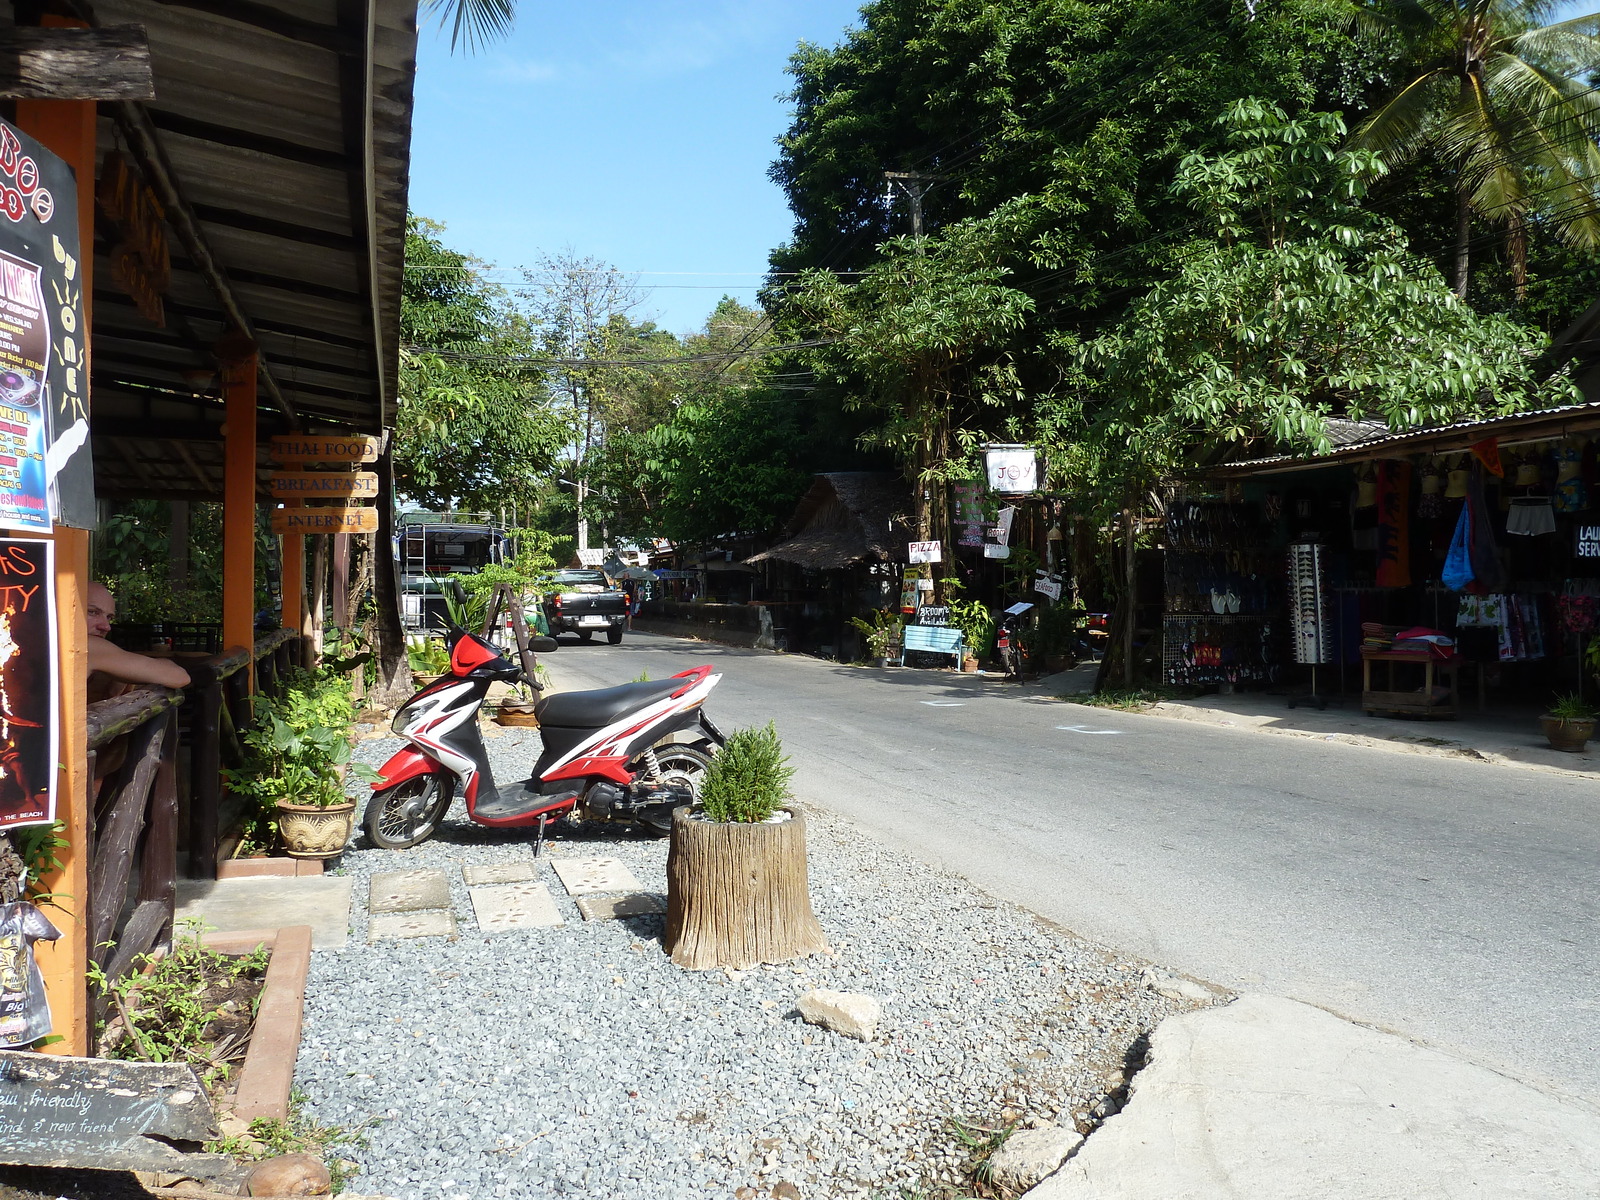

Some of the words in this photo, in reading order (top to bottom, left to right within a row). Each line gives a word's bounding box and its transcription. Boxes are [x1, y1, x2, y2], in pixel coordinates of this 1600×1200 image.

[7, 302, 39, 320] BEACH
[277, 443, 319, 455] THAI
[325, 442, 373, 457] FOOD
[997, 464, 1031, 481] JOY
[276, 478, 374, 491] BREAKFAST
[286, 514, 365, 528] INTERNET
[910, 542, 940, 553] PIZZA
[20, 811, 43, 819] BEACH
[29, 1089, 92, 1116] friendly
[49, 1122, 76, 1133] new
